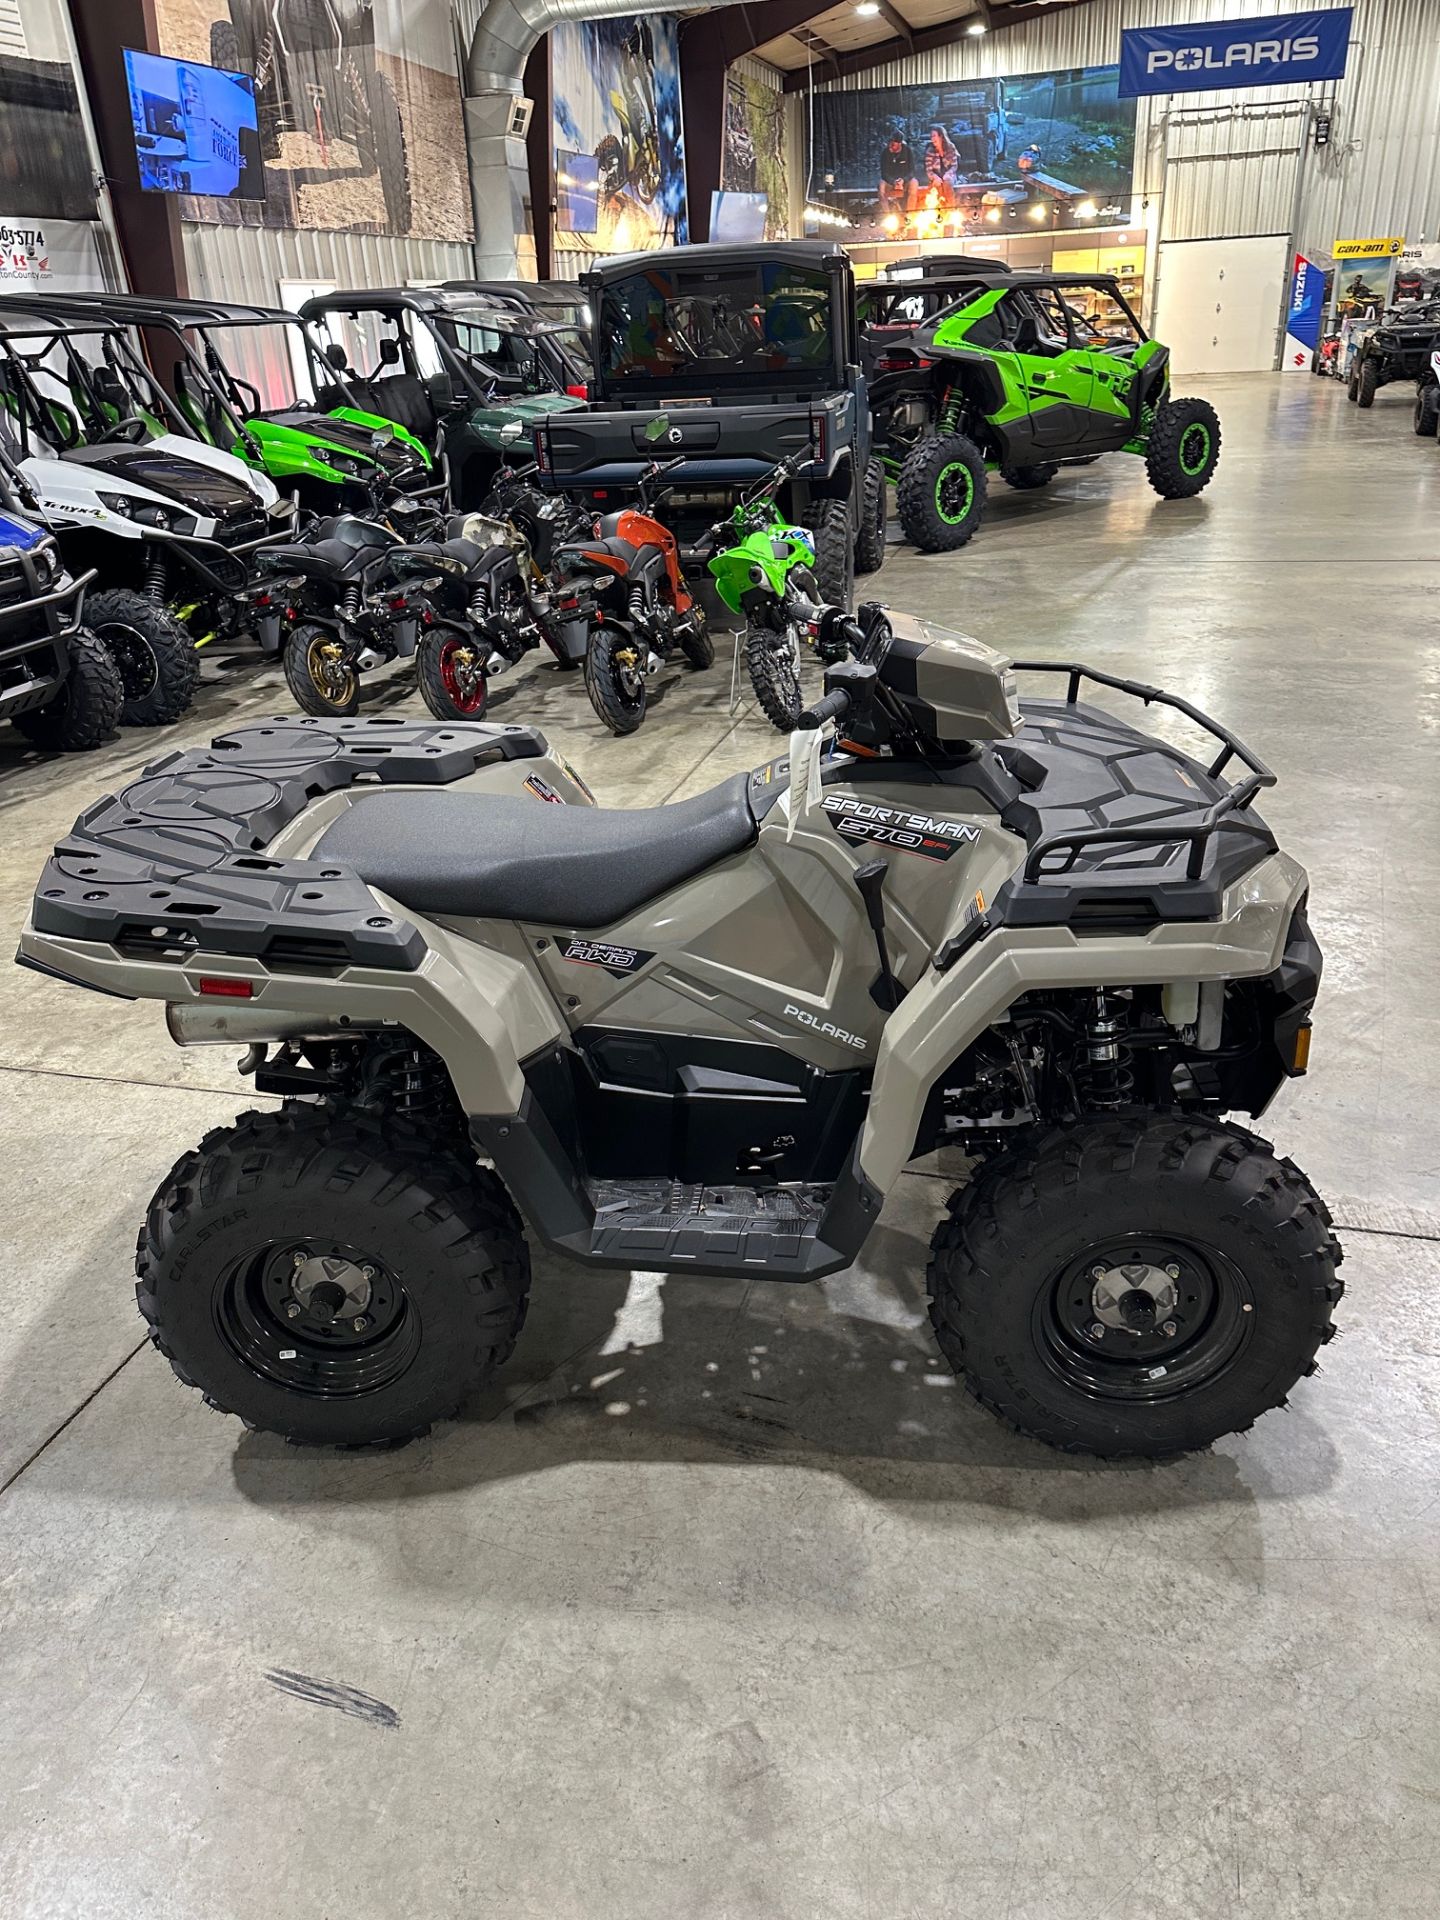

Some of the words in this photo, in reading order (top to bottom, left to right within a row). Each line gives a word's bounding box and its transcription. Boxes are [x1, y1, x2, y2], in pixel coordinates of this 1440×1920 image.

[1146, 36, 1320, 74] POLARIS
[0, 225, 45, 247] 63-5774
[1337, 243, 1385, 254] can-am
[1293, 261, 1308, 312] SUZUKI
[780, 530, 811, 540] KX
[820, 795, 981, 842] SPORTSMAN
[837, 817, 924, 848] 570
[922, 839, 951, 851] EPI
[564, 945, 635, 967] AWD
[590, 943, 638, 956] DEMAND
[783, 1003, 868, 1050] POLARIS
